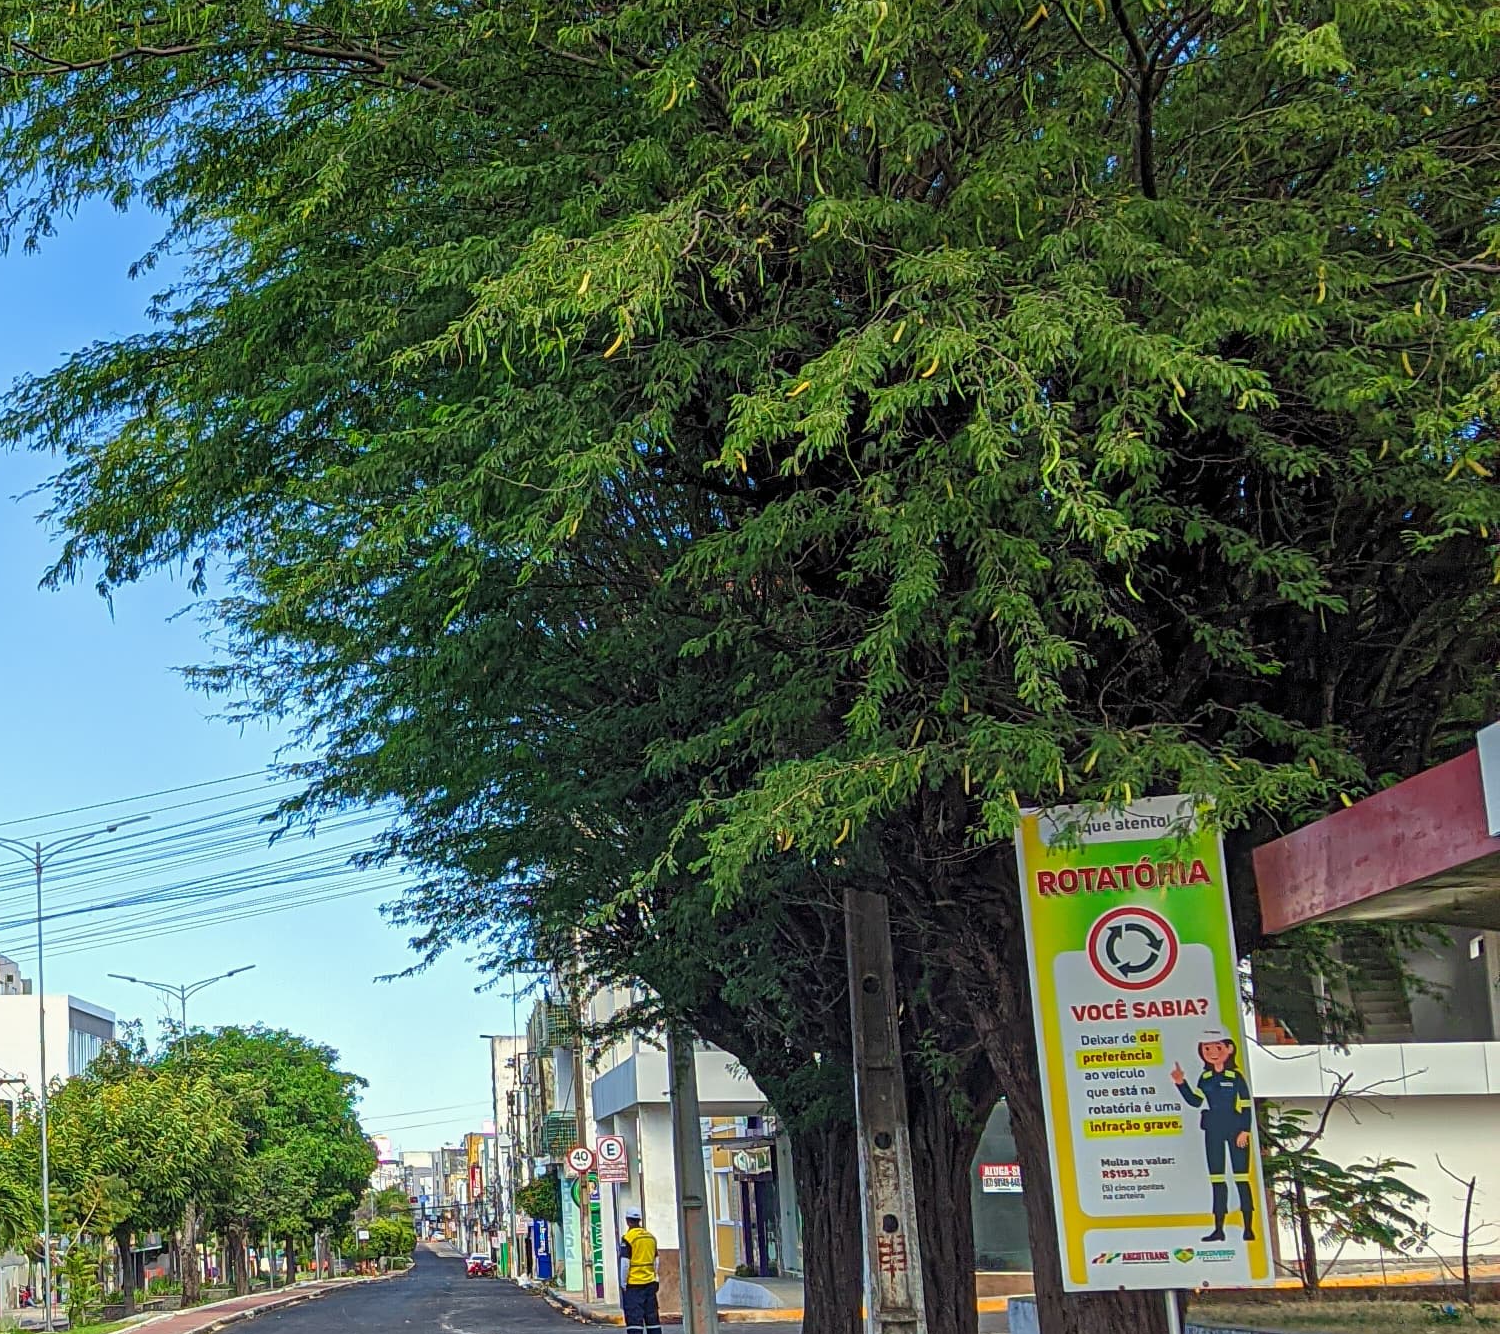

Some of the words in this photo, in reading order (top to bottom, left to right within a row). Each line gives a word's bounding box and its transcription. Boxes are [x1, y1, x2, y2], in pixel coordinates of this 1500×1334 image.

[1115, 814, 1170, 831] atento!
[1037, 856, 1212, 896] ROTATÓRIA
[1071, 999, 1128, 1022] VOCÊ
[1132, 998, 1209, 1019] SABIA?
[1081, 1035, 1119, 1046] Deixar
[1121, 1033, 1137, 1044] de
[1139, 1032, 1160, 1043] dar
[1082, 1049, 1153, 1065] preferência
[1084, 1071, 1100, 1080] ao
[1102, 1067, 1146, 1080] veículo
[1086, 1088, 1109, 1099] que
[1111, 1084, 1138, 1096] está
[1141, 1085, 1156, 1095] na
[1088, 1101, 1142, 1115] rotatória
[1144, 1100, 1152, 1112] é
[1155, 1102, 1182, 1112] uma
[1090, 1119, 1141, 1133] infração
[1143, 1119, 1183, 1132] grave.
[573, 1151, 588, 1162] 40
[606, 1143, 616, 1156] E
[1100, 1158, 1130, 1167] Multa
[1131, 1158, 1144, 1166] no
[1101, 1169, 1150, 1179] R$195,23
